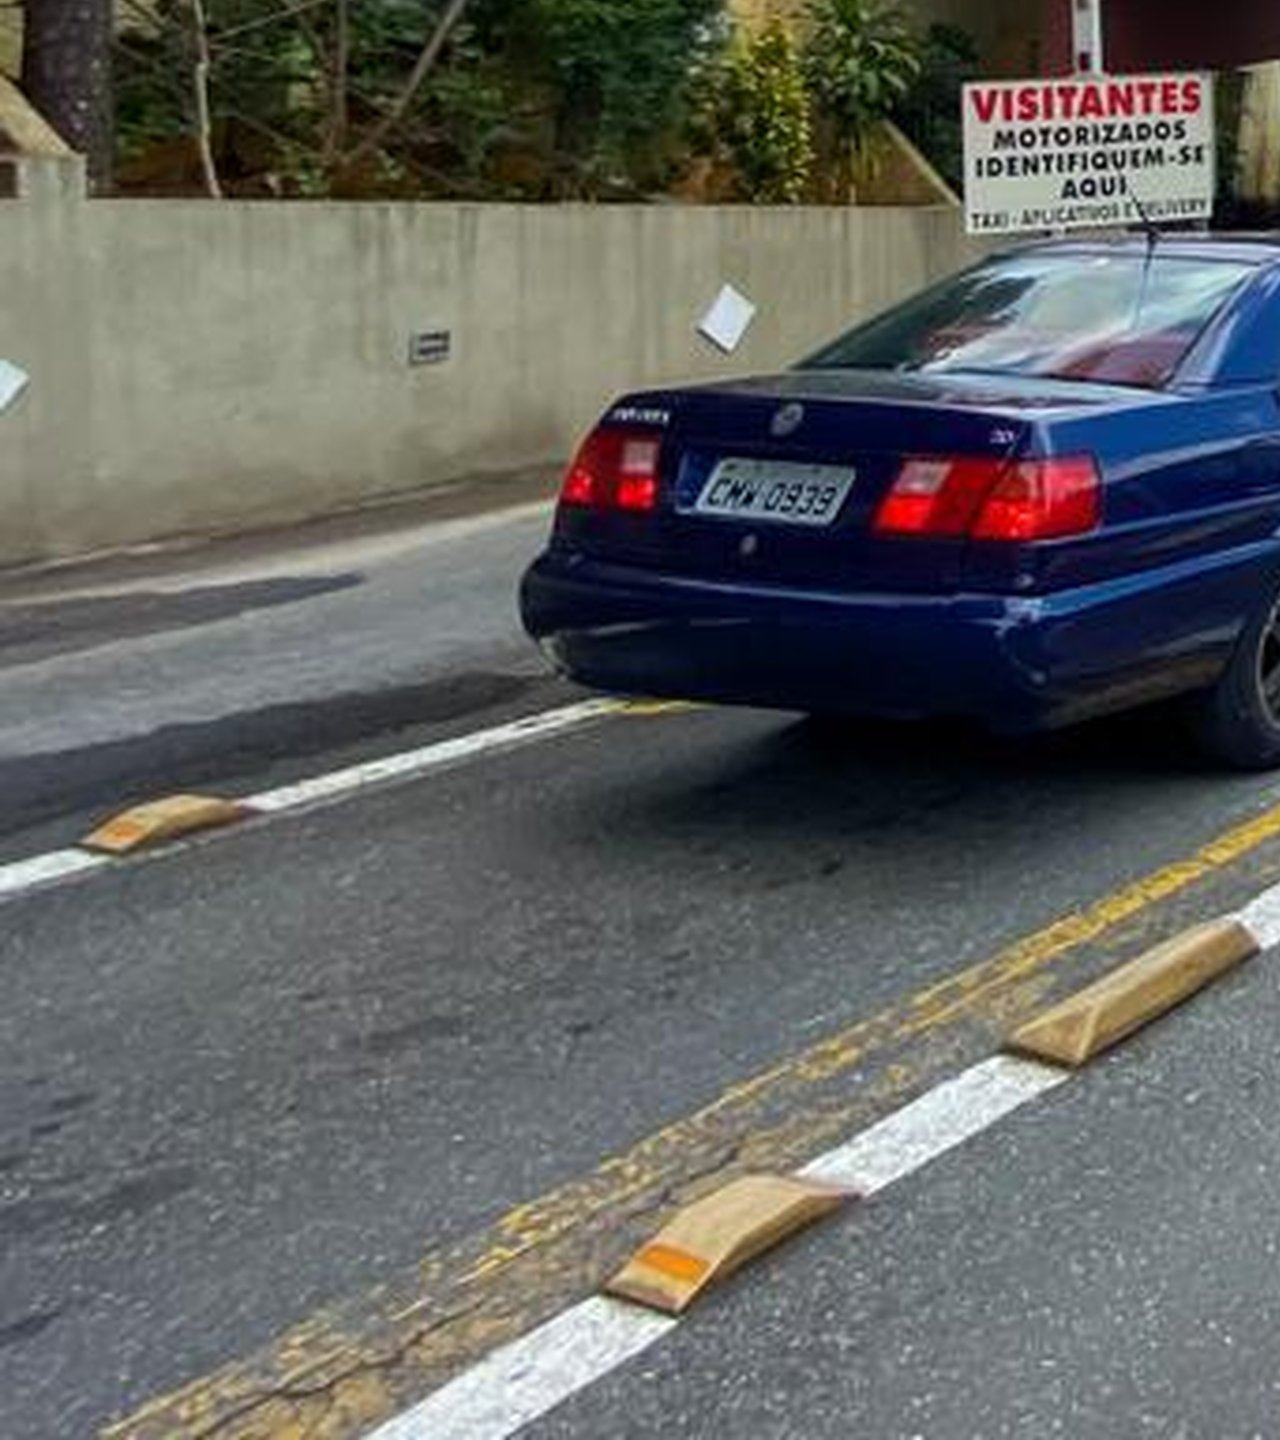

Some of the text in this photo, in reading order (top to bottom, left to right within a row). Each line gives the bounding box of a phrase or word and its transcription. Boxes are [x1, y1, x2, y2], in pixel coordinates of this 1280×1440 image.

[972, 80, 1201, 122] VISITANTES
[994, 120, 1186, 150] MOTORIZADOS
[976, 145, 1204, 178] IDENTIFIQUEM-SE
[1061, 176, 1127, 199] AQUI
